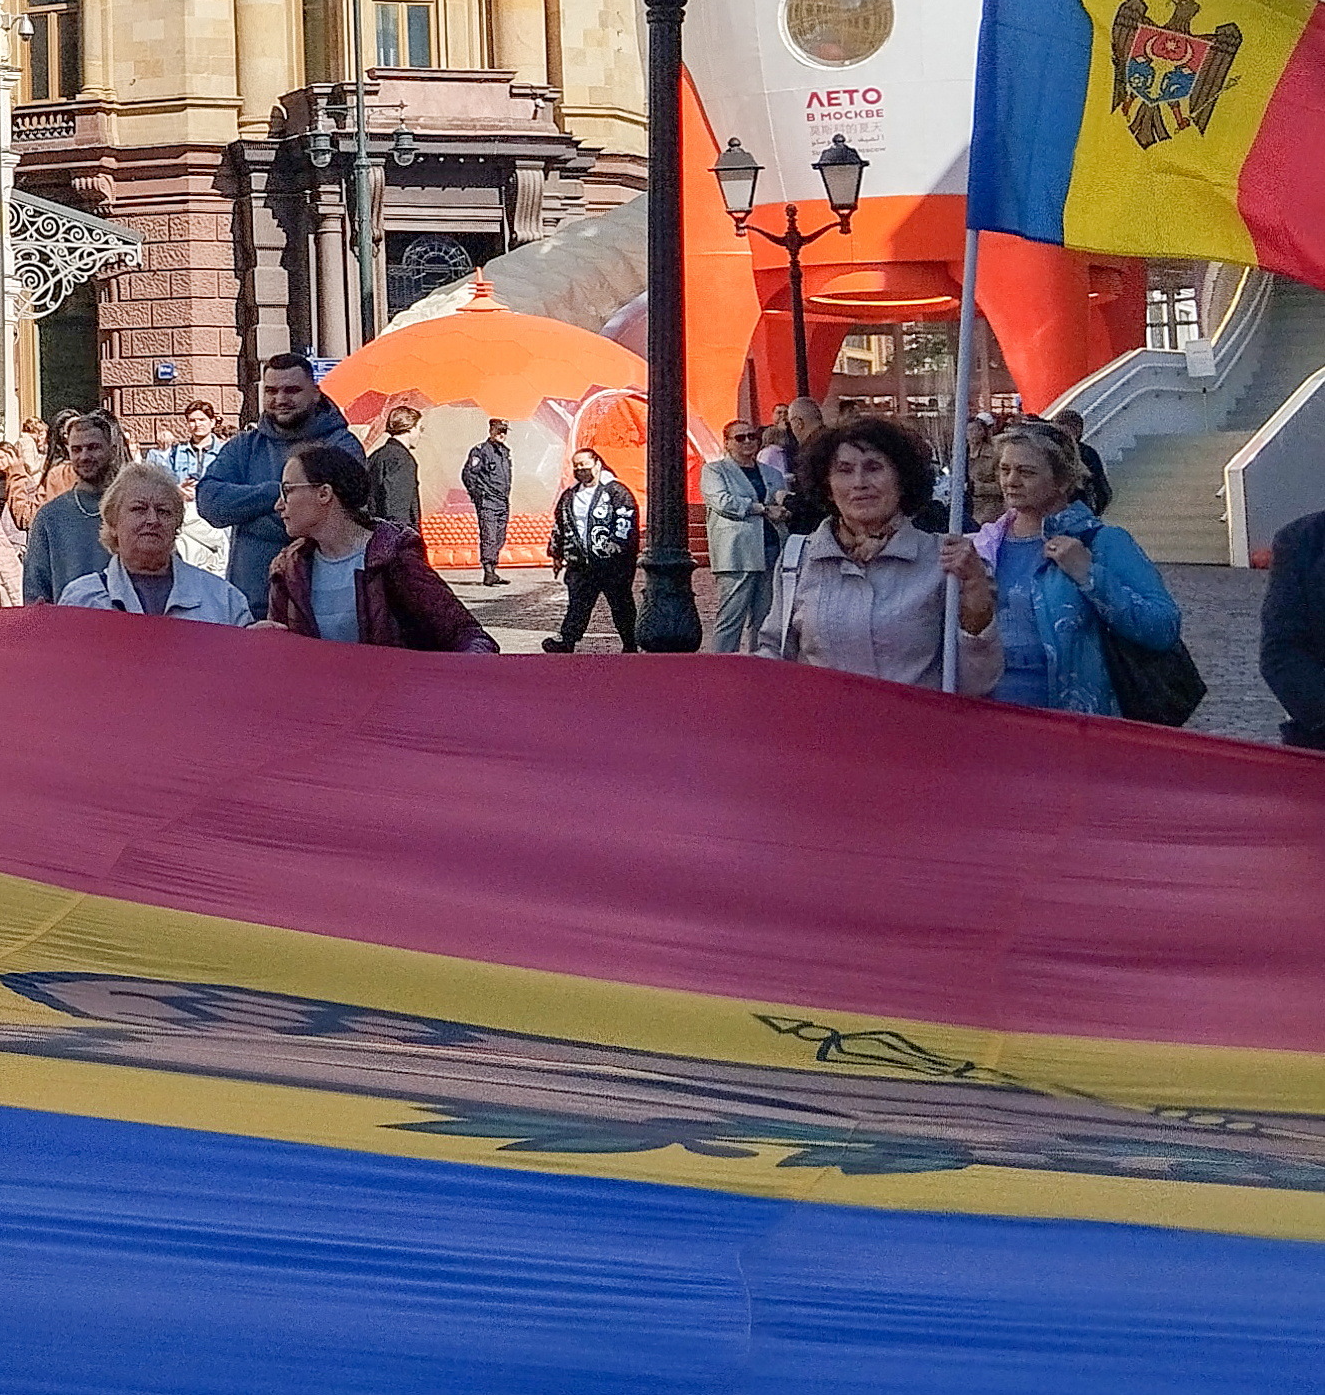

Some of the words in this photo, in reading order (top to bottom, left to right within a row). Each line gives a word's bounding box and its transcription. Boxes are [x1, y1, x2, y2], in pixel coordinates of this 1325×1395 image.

[806, 88, 882, 108] ЛЕТО
[806, 113, 815, 122] В
[820, 109, 884, 121] МОСКВЕ
